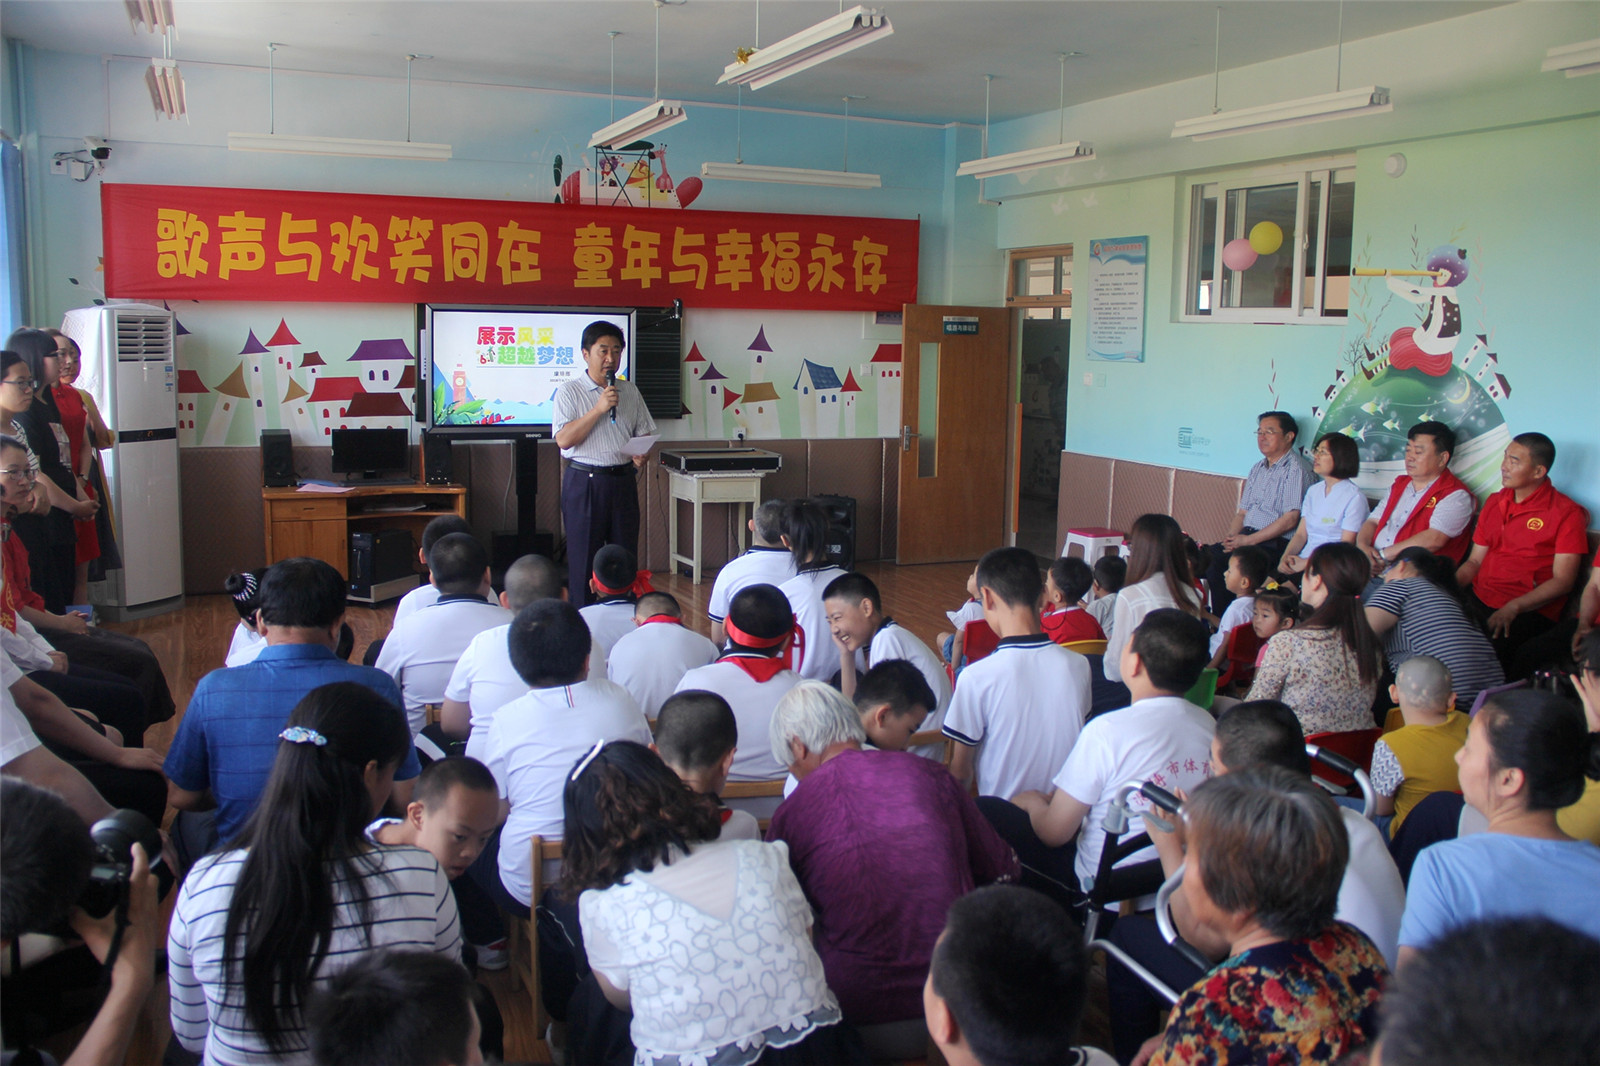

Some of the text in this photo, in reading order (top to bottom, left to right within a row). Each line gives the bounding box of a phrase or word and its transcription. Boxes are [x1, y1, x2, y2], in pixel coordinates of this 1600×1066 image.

[157, 208, 888, 294] 歌声与欢笑同在 童年与幸福永存
[477, 326, 554, 346] 展示风采
[497, 346, 574, 365] 超越梦想
